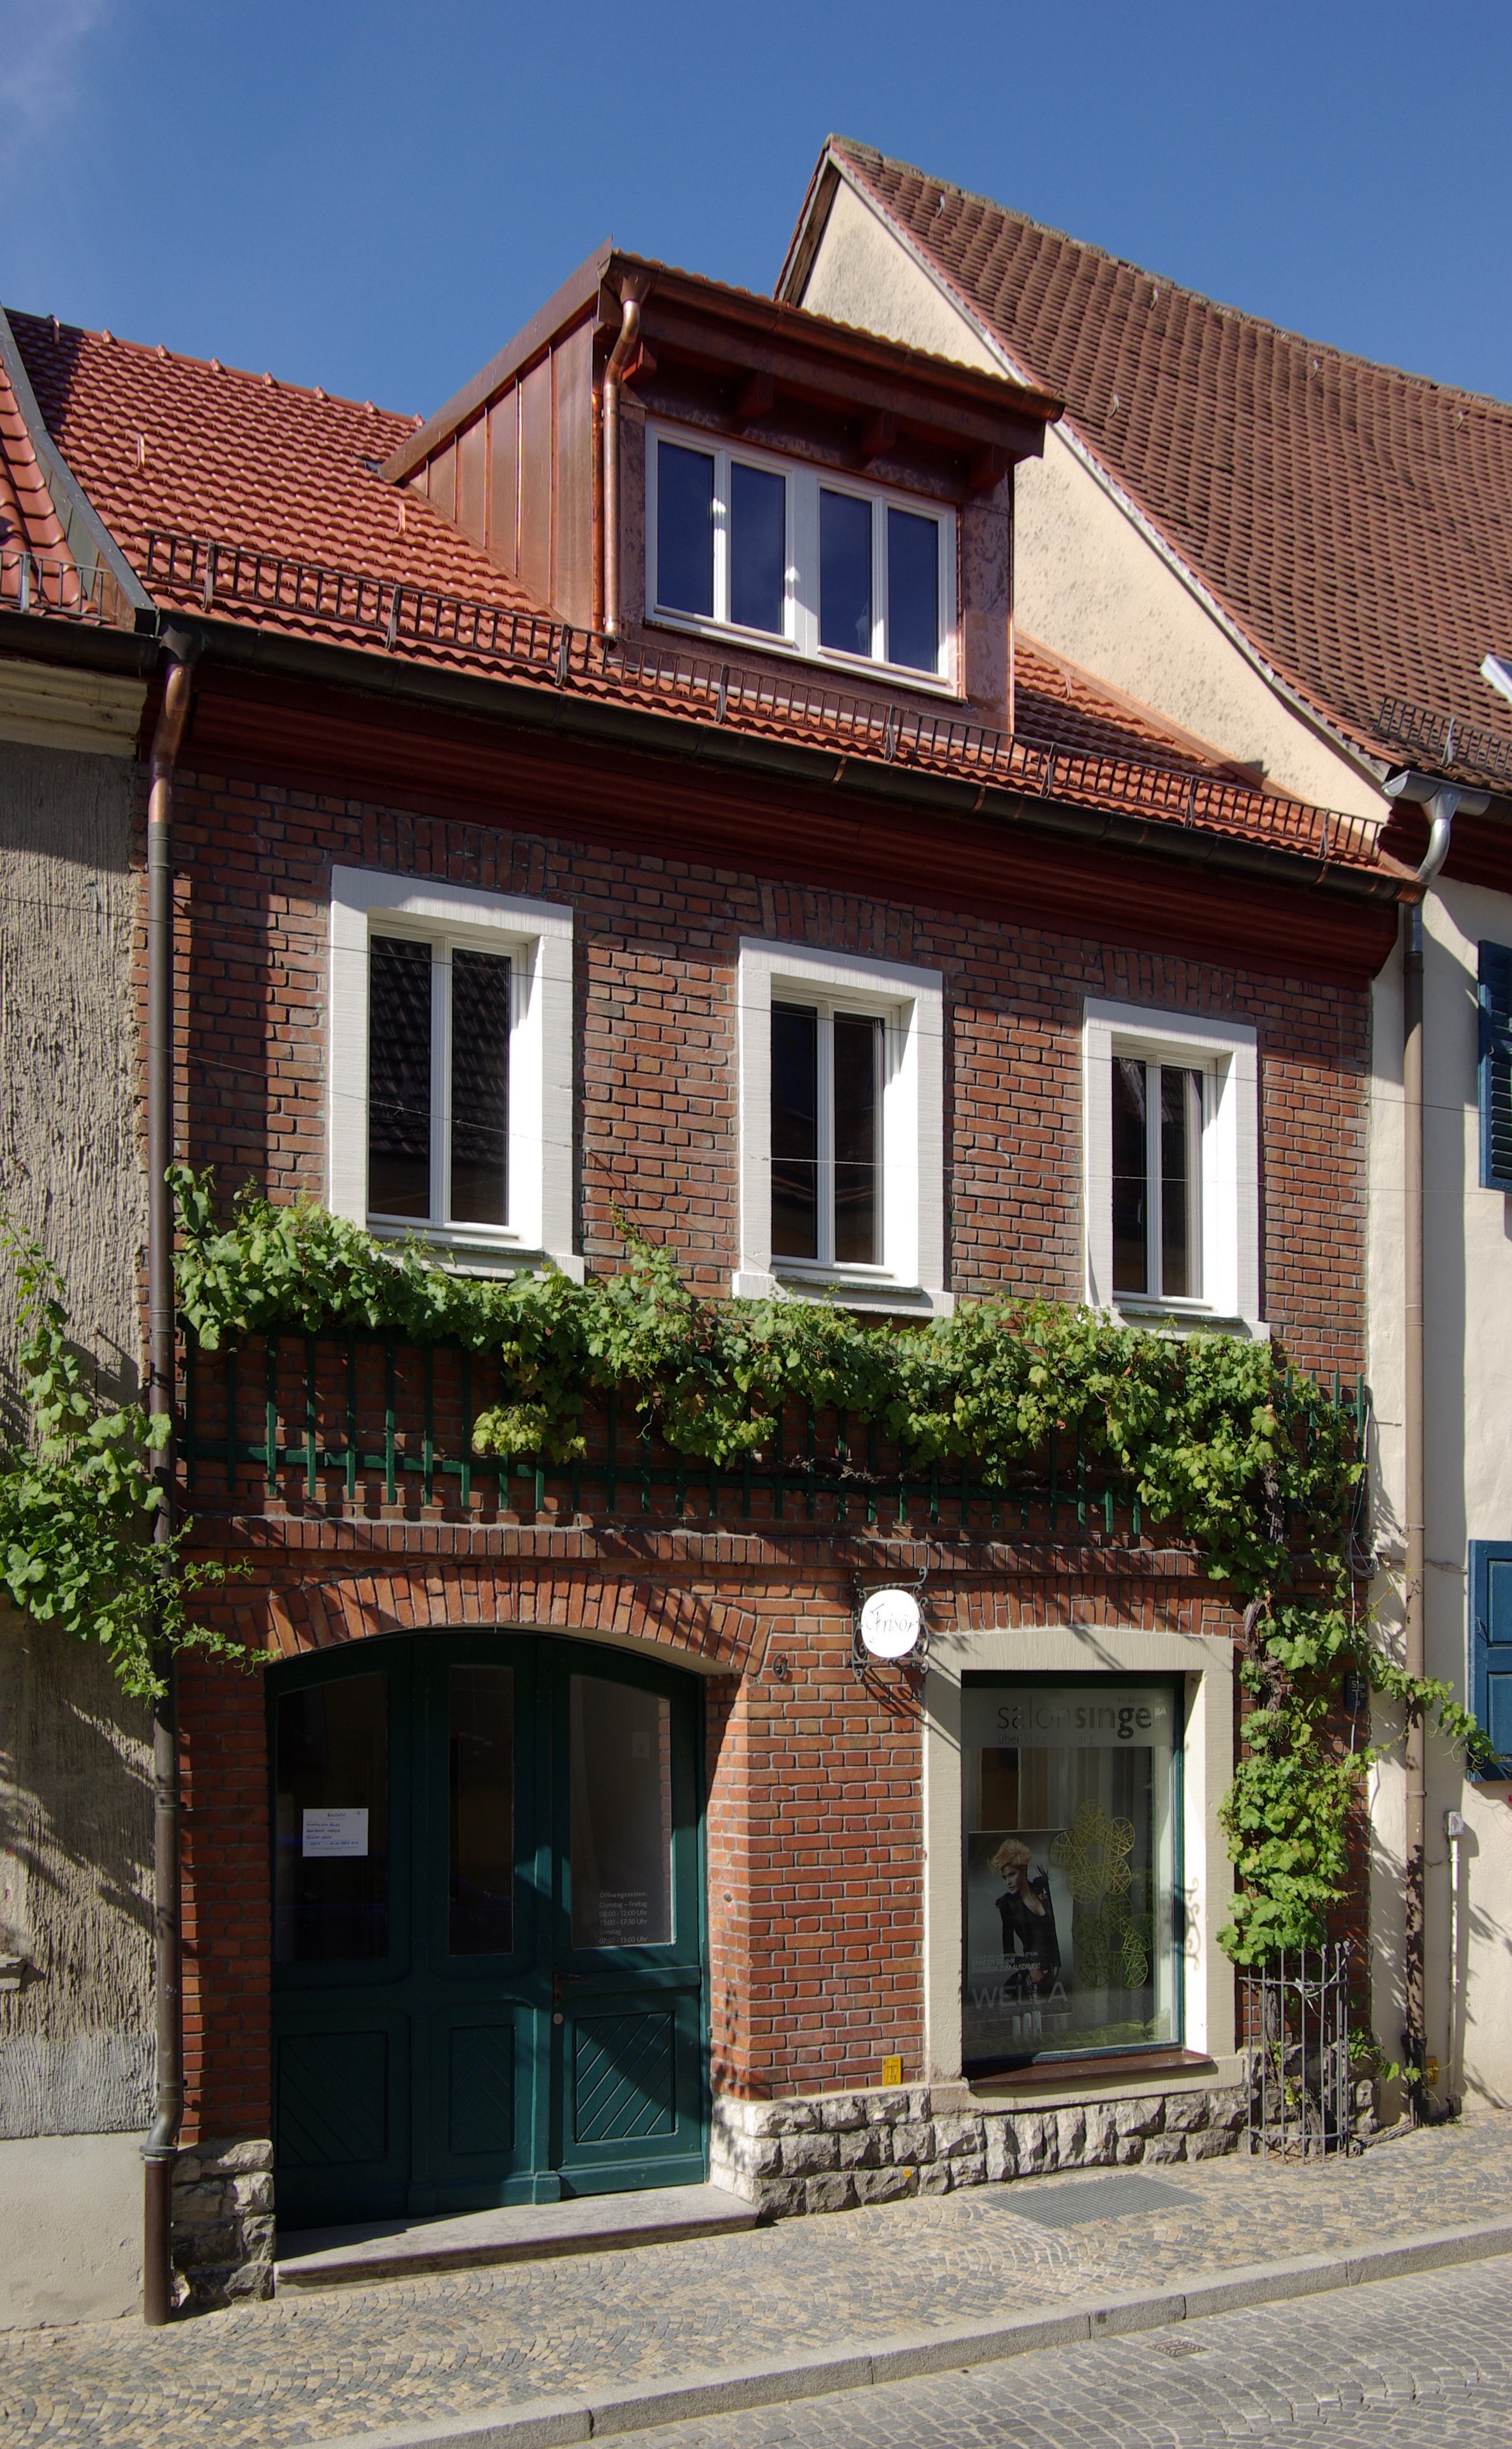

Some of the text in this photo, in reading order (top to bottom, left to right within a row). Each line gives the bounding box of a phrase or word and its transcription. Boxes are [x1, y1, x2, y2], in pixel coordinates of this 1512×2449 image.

[866, 1603, 915, 1643] Frisör
[998, 1733, 1019, 1745] über
[972, 1965, 998, 1974] CHARISMA
[972, 1981, 1069, 2011] WELLA
[999, 2004, 1070, 2015] PROFESIONALS
